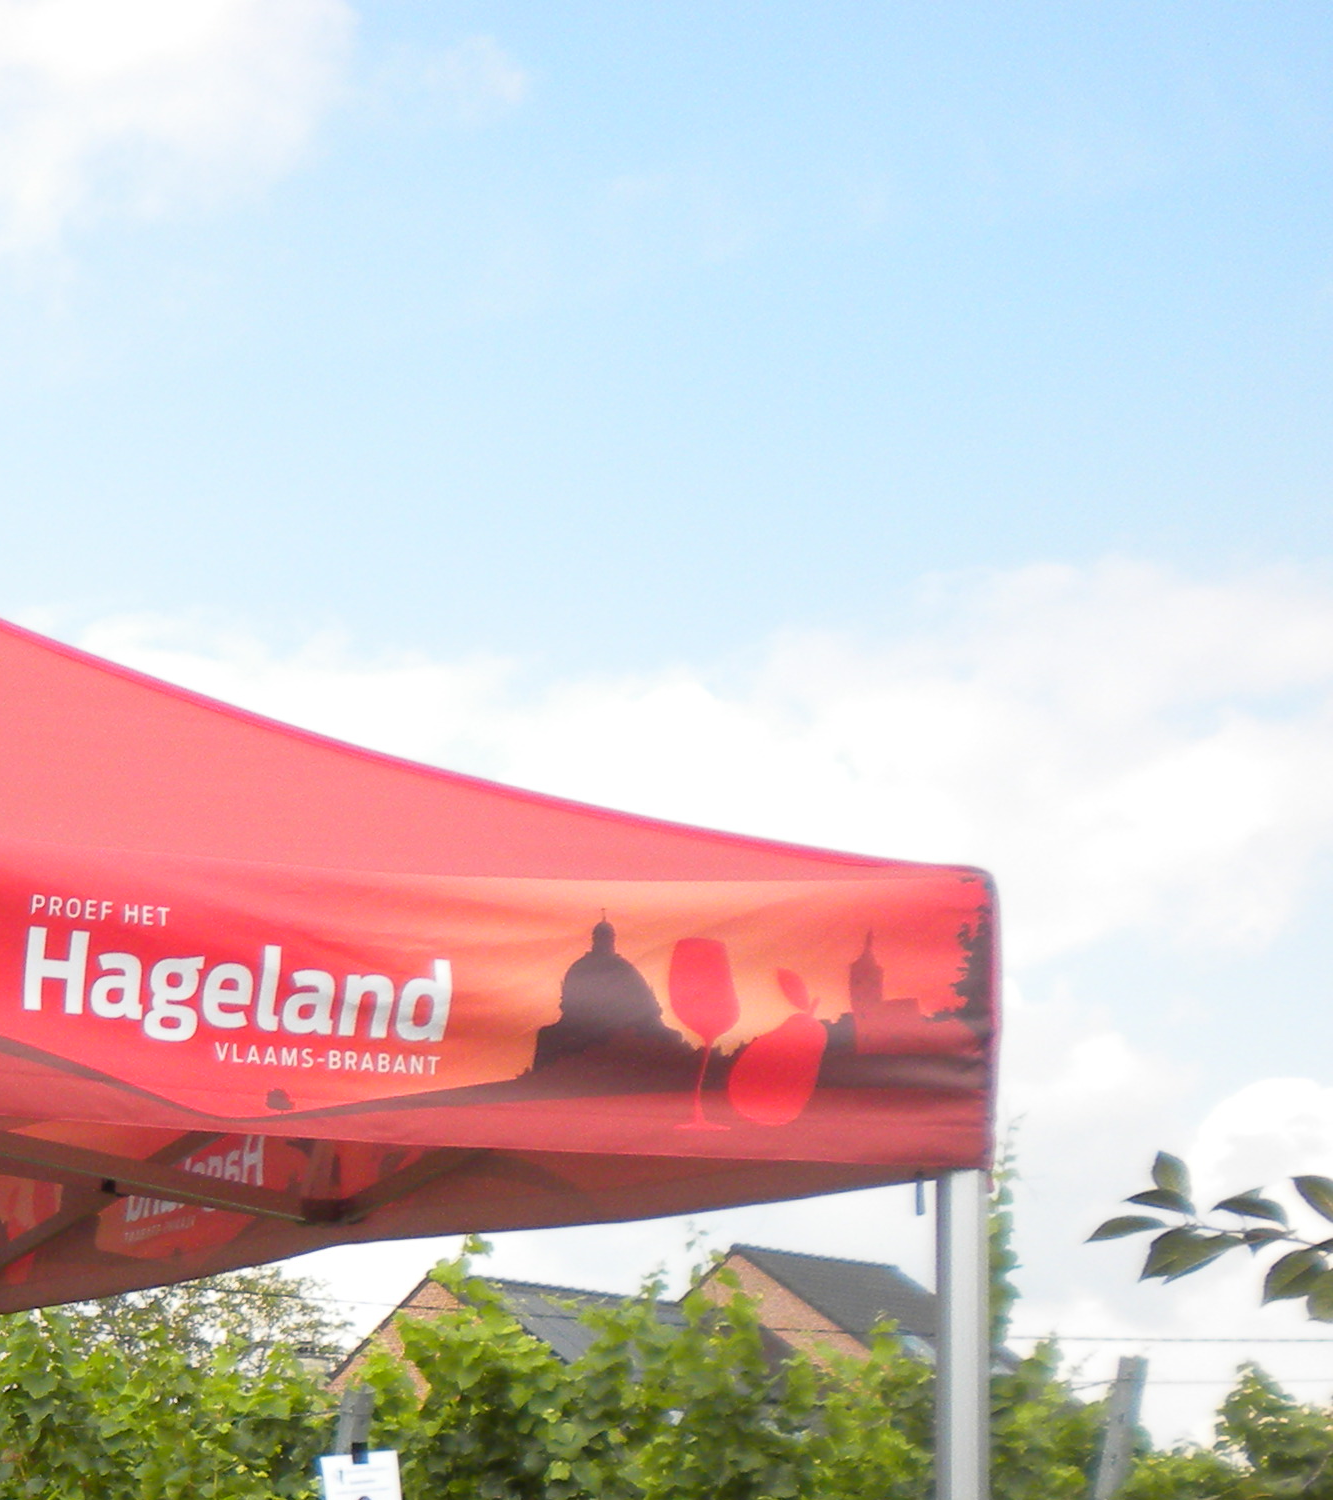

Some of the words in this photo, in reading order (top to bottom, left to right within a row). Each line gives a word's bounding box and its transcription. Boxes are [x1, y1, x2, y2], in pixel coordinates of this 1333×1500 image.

[31, 894, 113, 921] PROEF
[124, 903, 171, 927] HET
[22, 925, 452, 1042] Hageland
[215, 1041, 441, 1075] VLAAMS-BRABANT
